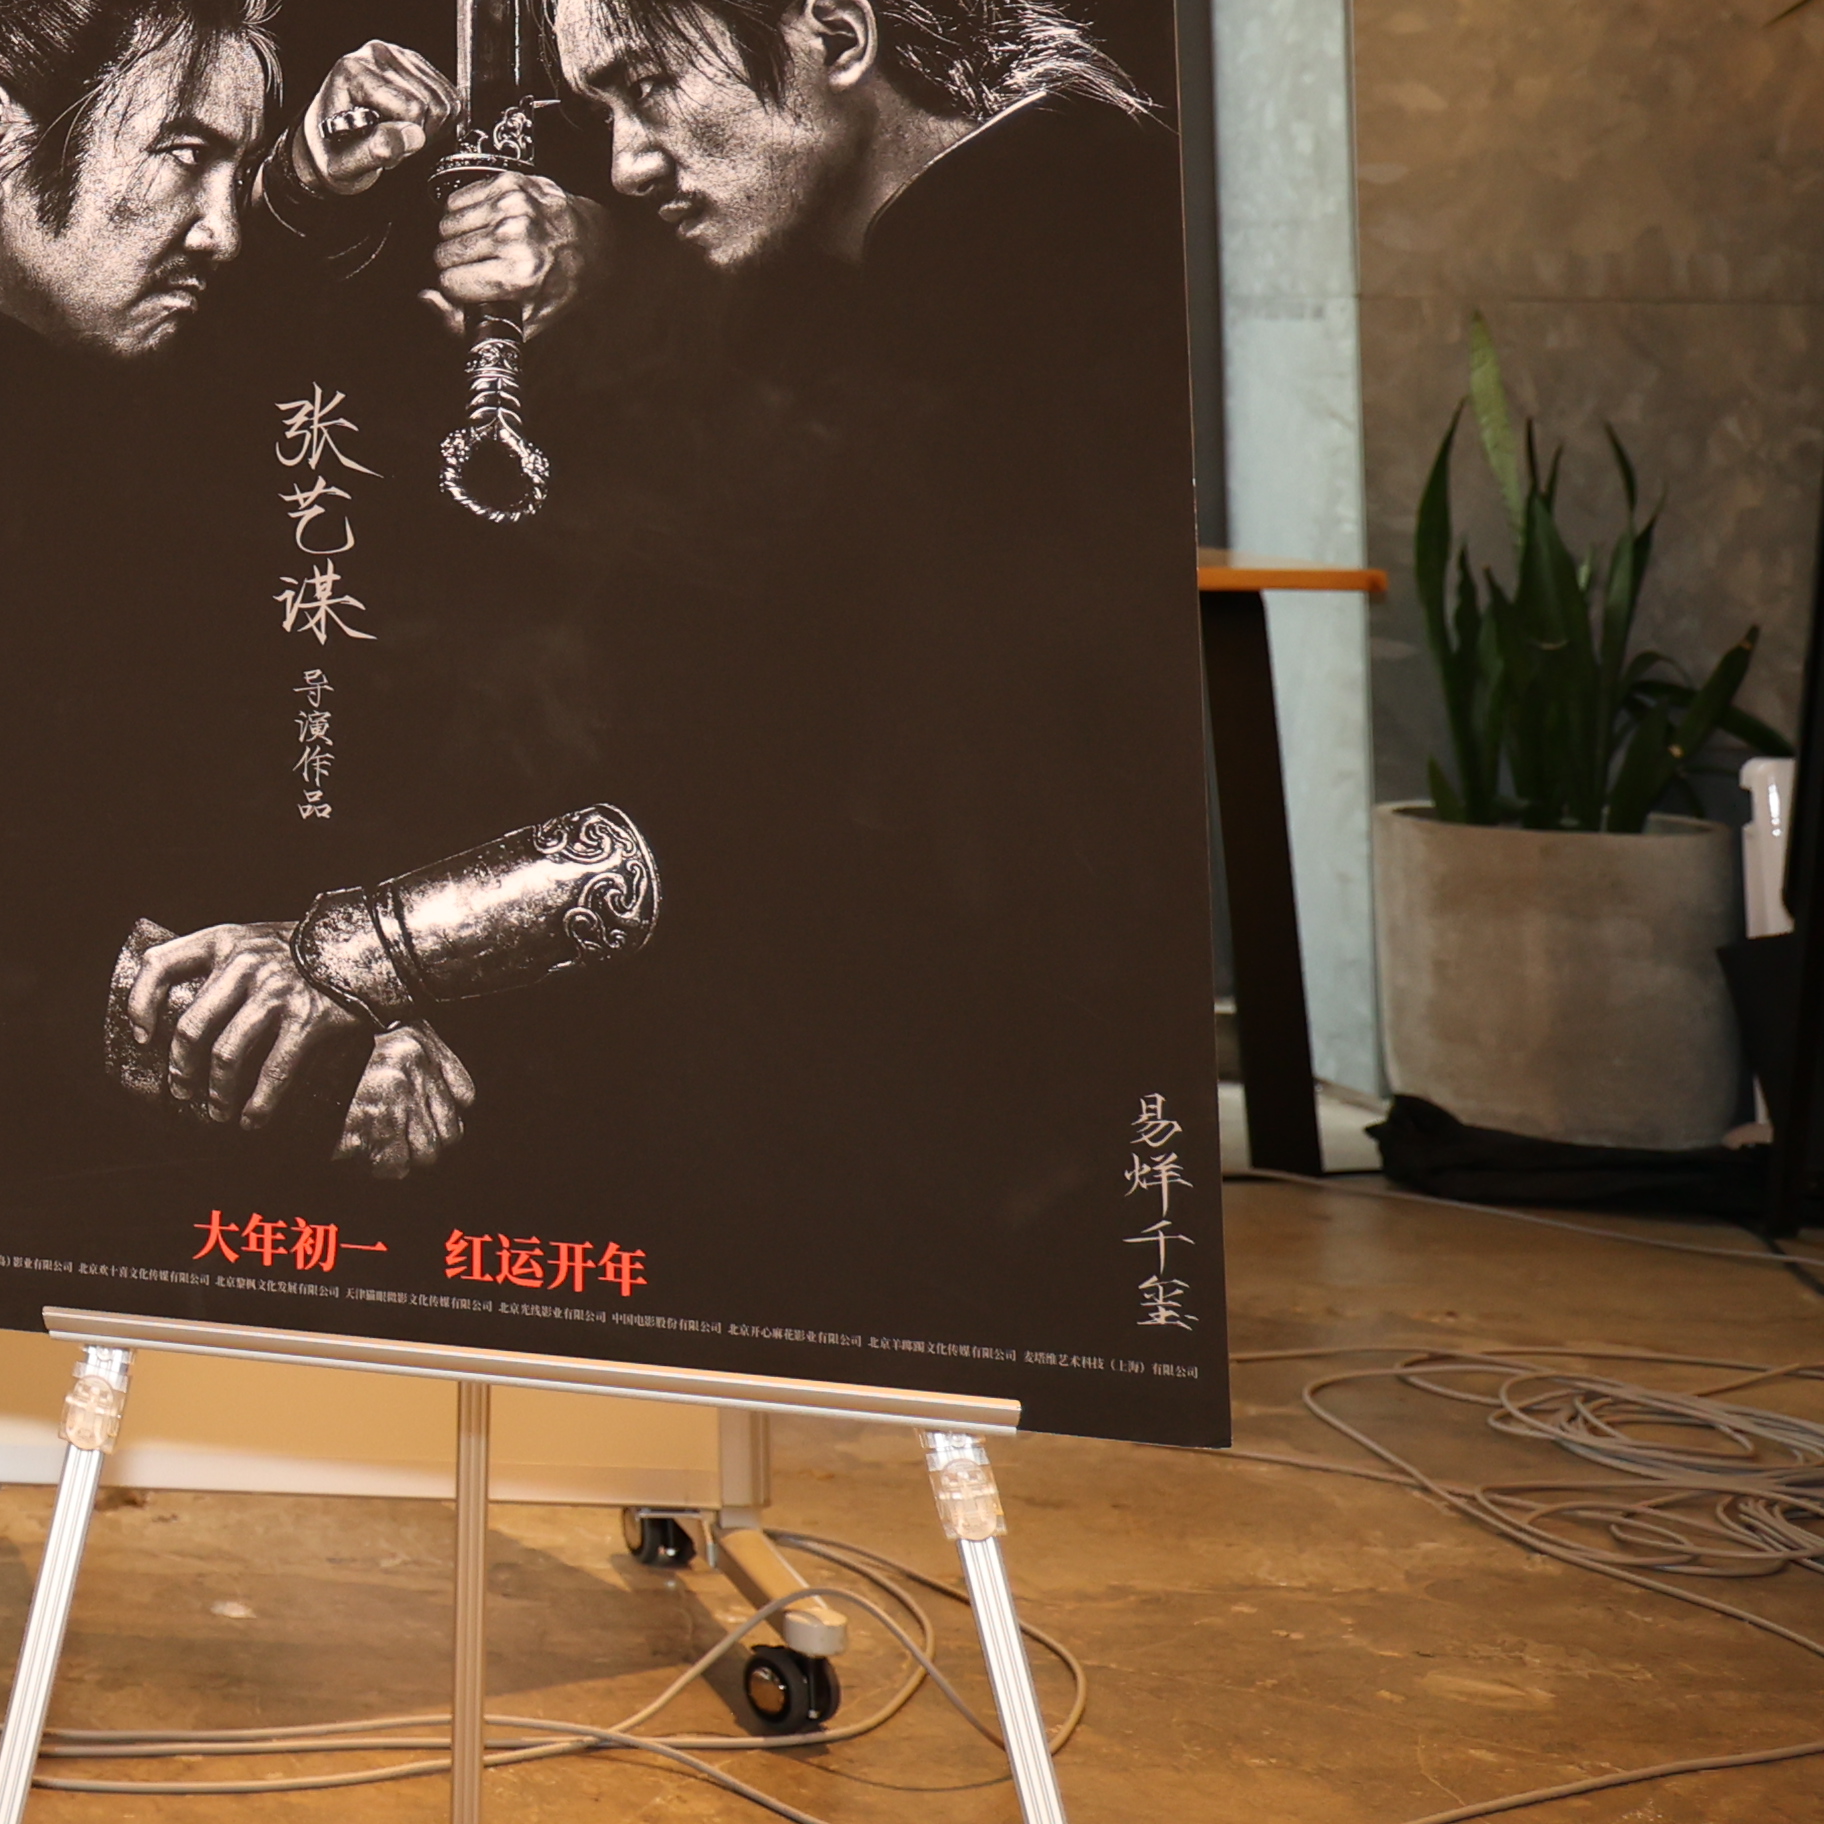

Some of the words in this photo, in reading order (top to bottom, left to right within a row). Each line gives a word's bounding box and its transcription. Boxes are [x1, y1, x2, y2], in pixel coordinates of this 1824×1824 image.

[273, 381, 384, 645] 张艺谋
[293, 668, 335, 820] 导演作品
[192, 1210, 388, 1272] 大年初一
[445, 1228, 648, 1297] 红运开年
[1123, 1093, 1199, 1331] 易烊千玺
[612, 1312, 722, 1335] 中国电影股份有限公司
